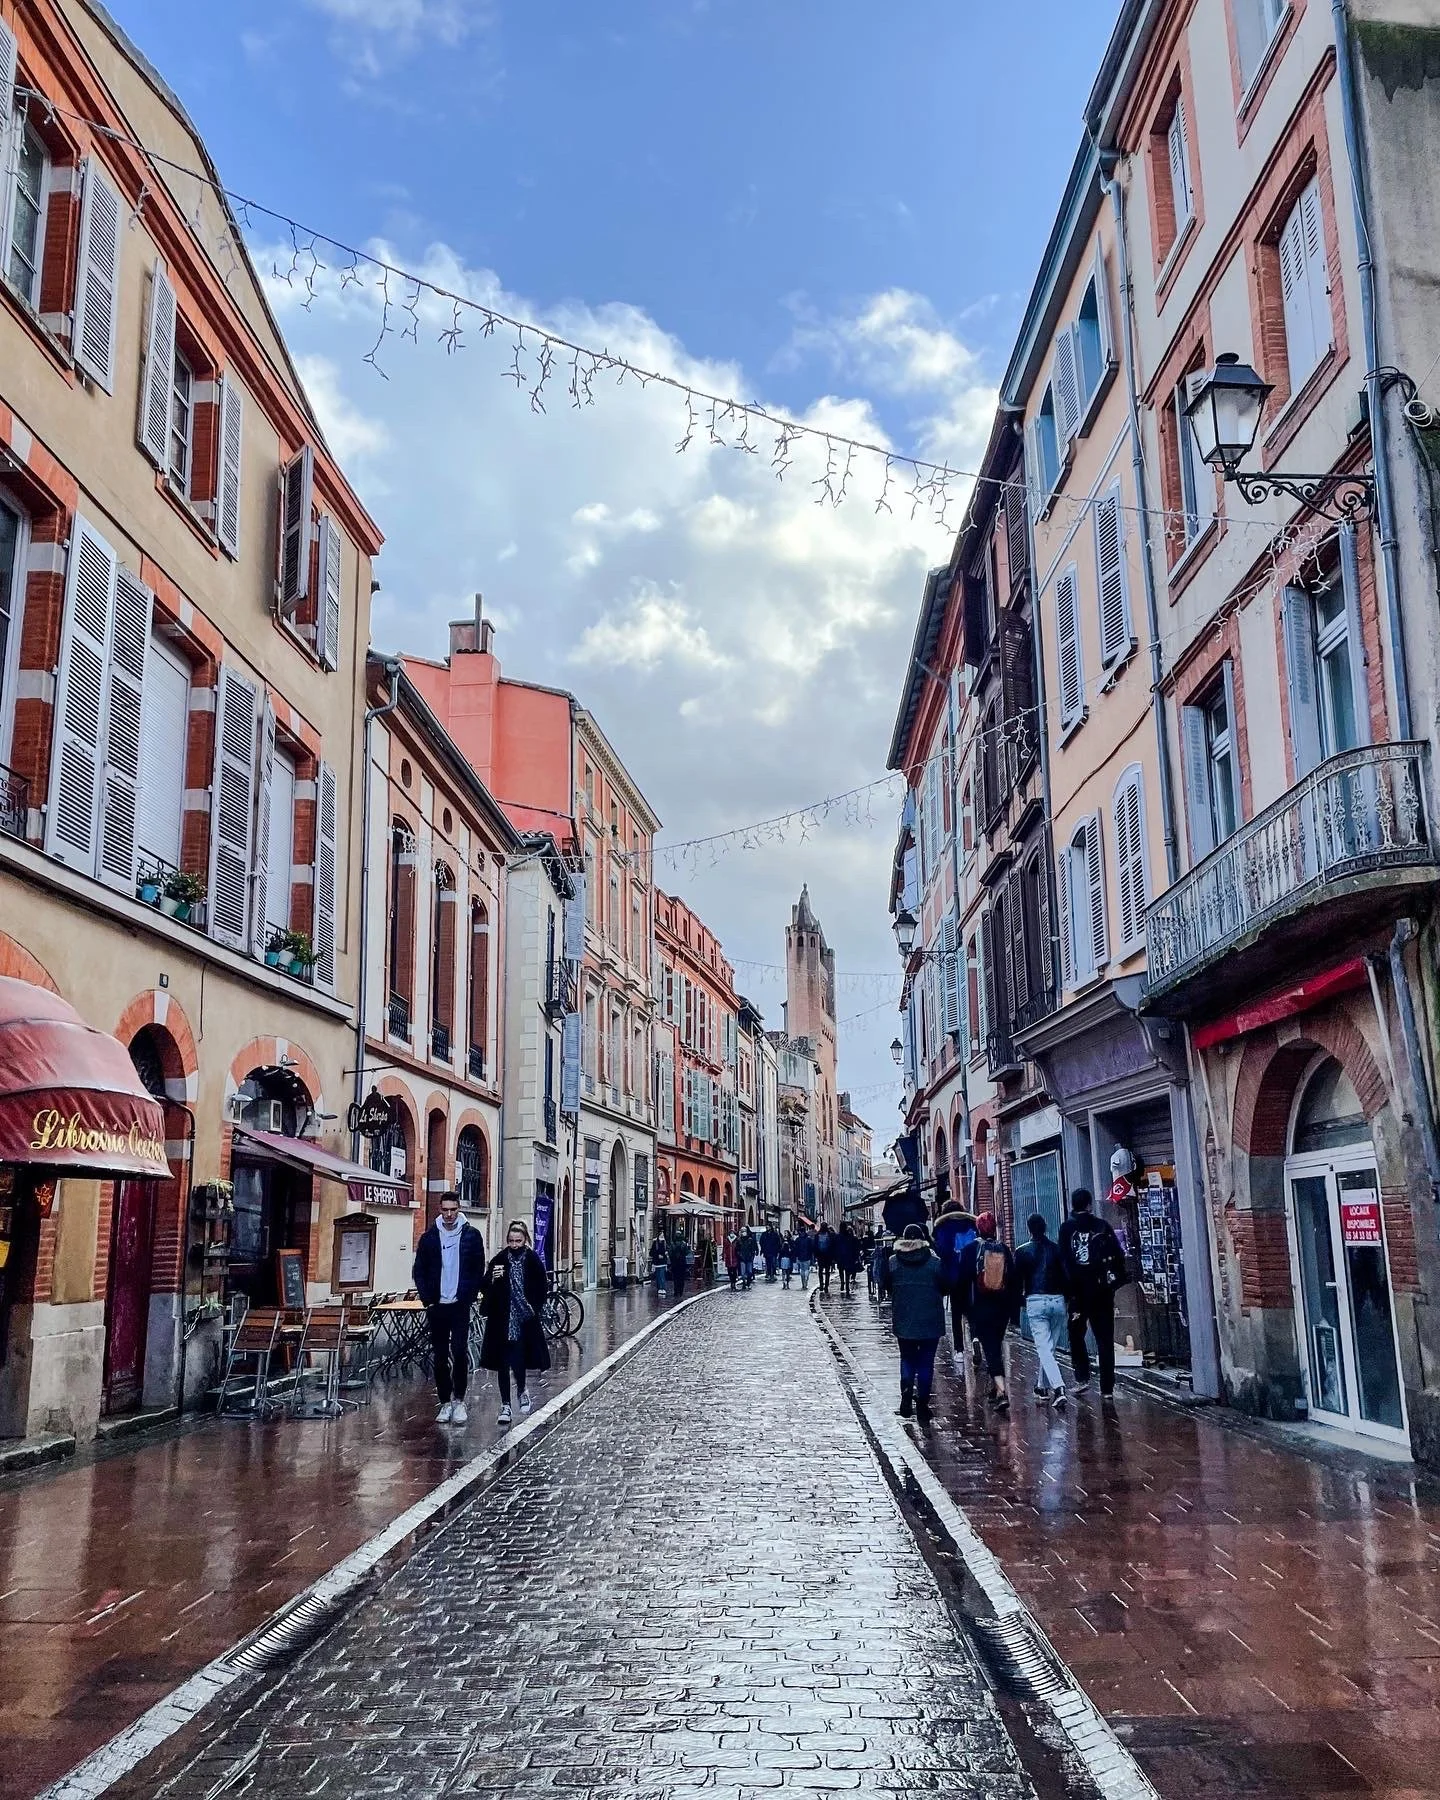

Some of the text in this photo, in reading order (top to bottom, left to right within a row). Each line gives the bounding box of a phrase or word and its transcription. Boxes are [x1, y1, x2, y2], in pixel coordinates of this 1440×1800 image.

[369, 1107, 388, 1125] Sherpa
[30, 1109, 126, 1154] Librairie
[364, 1184, 397, 1205] LE SHERPA
[1349, 1205, 1370, 1216] LOCAUX
